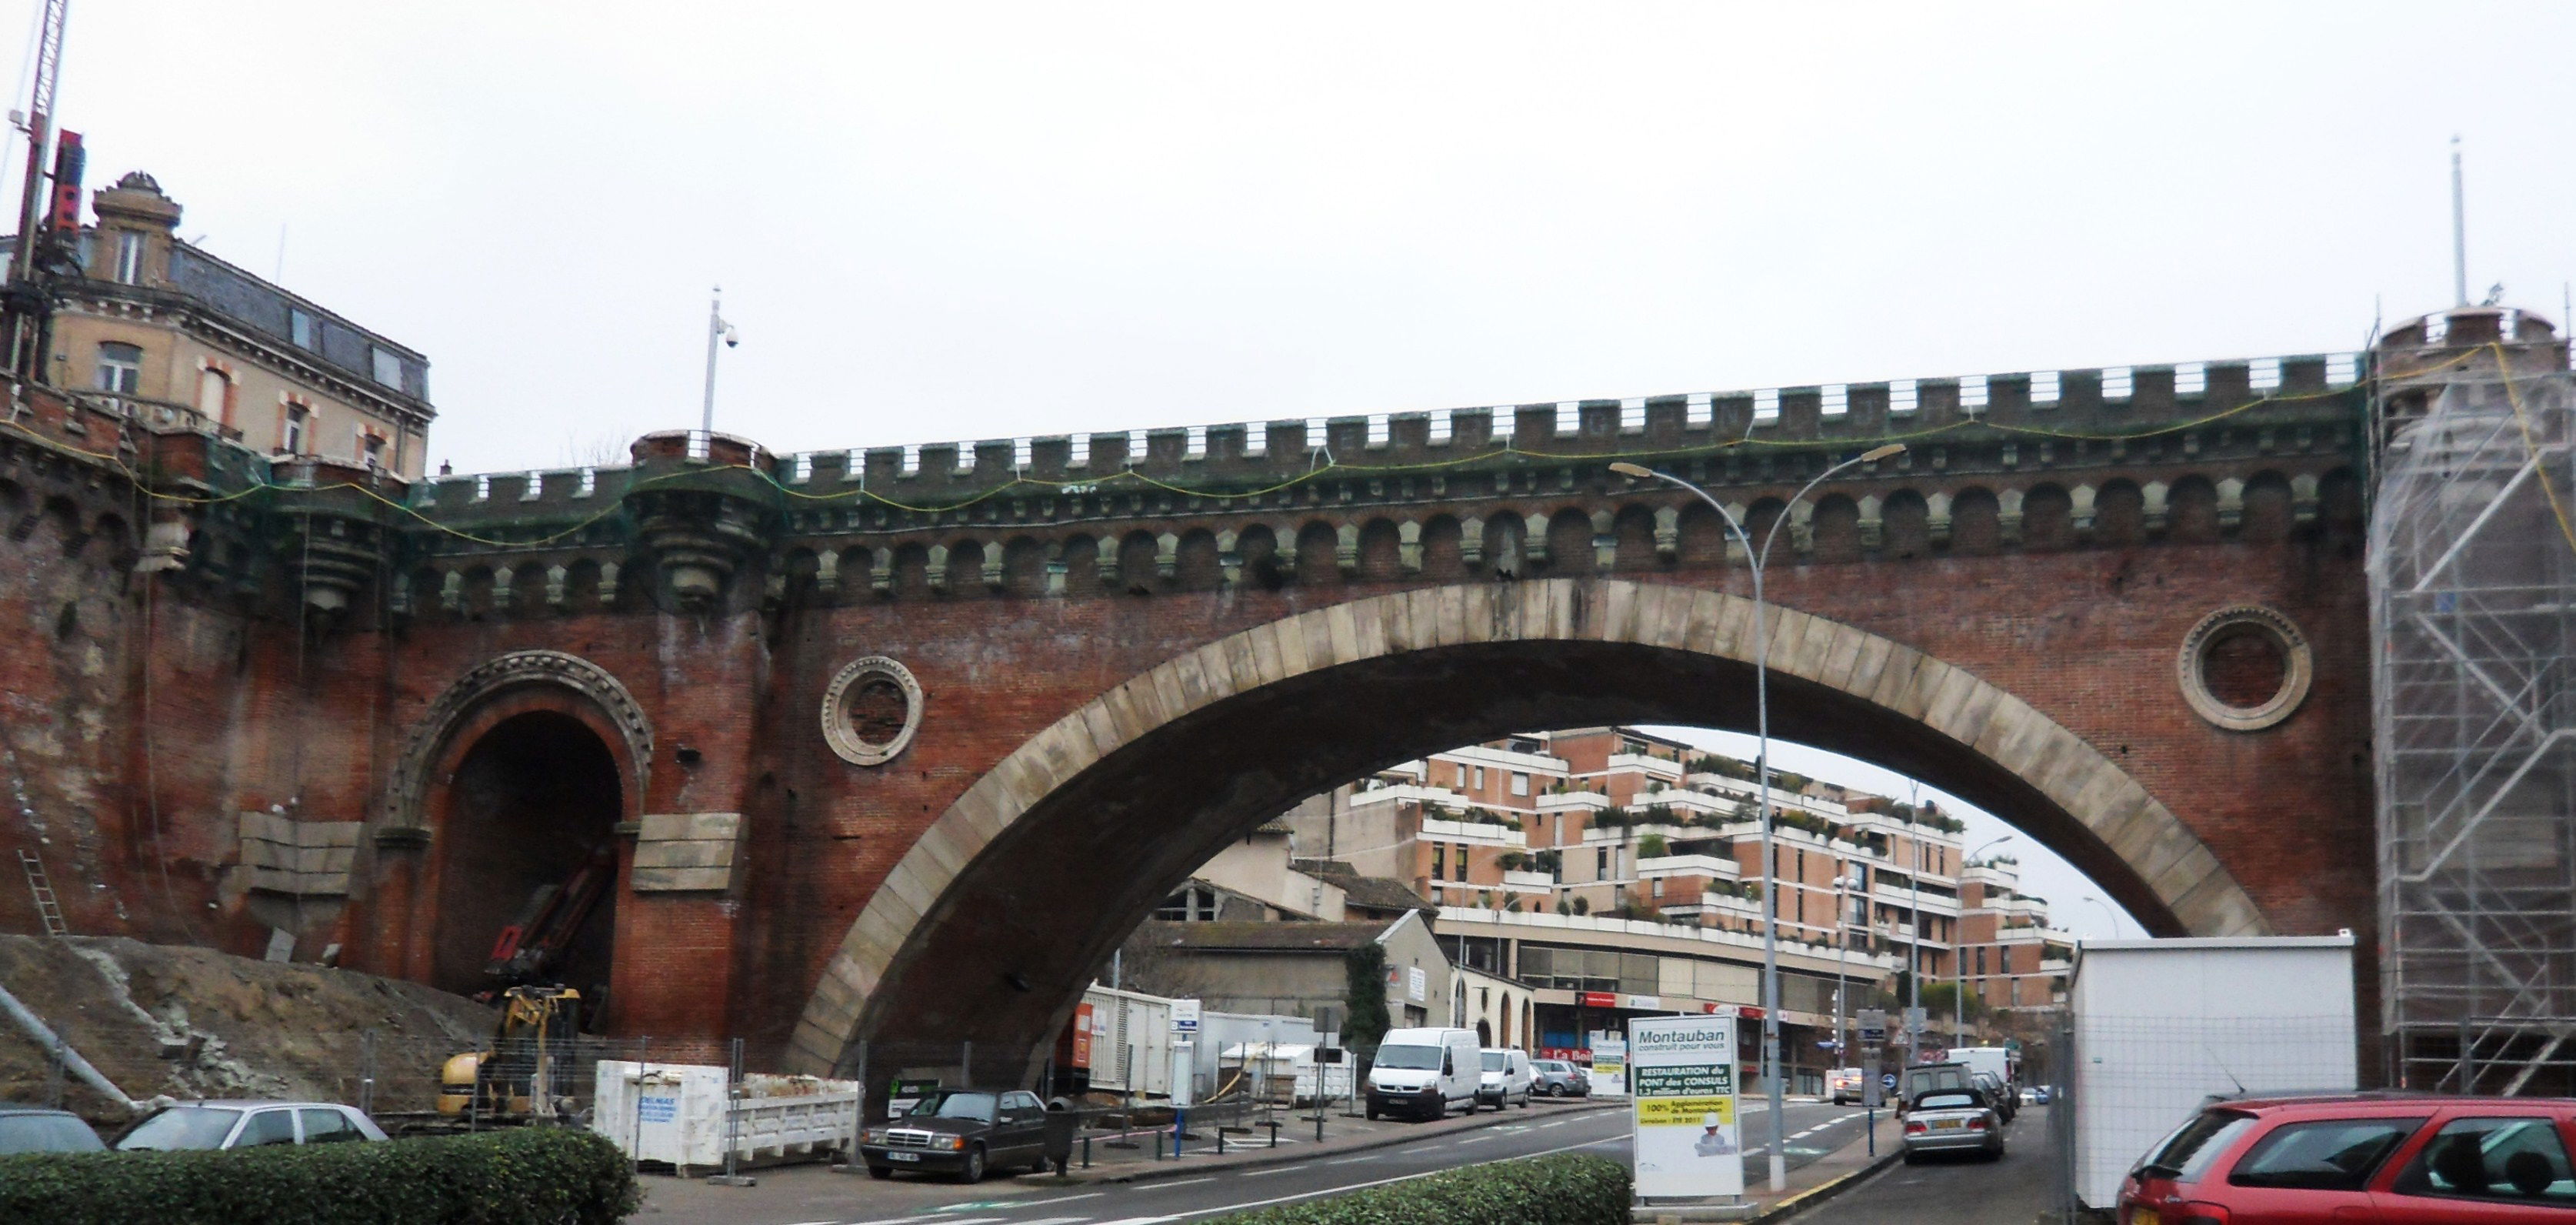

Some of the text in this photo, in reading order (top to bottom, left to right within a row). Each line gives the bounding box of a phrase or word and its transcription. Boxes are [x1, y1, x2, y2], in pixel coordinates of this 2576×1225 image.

[1639, 1030, 1725, 1043] Montauban
[1641, 1066, 1724, 1076] RESTAURATION du
[1684, 1076, 1728, 1086] CONSULS
[1647, 1103, 1669, 1112] 100%
